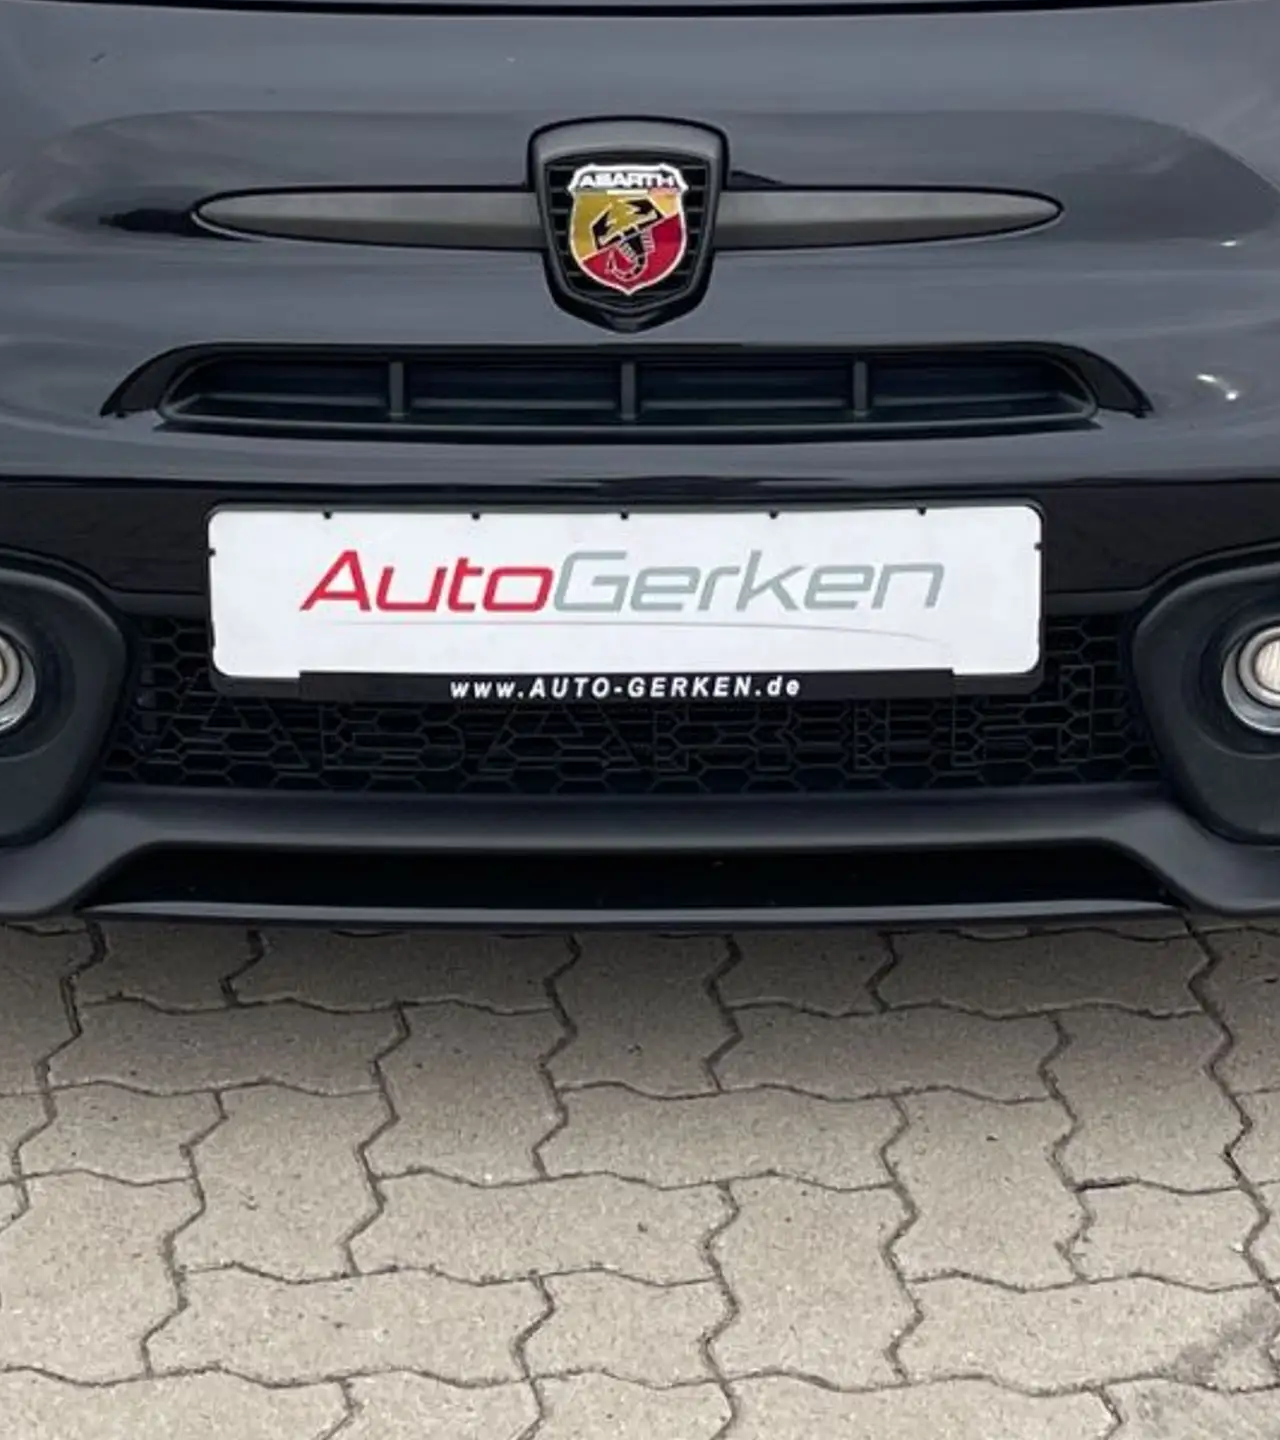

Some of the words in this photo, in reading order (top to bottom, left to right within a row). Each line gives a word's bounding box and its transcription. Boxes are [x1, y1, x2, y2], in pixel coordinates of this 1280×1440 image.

[579, 171, 677, 189] ABARTH
[299, 548, 946, 614] AutoGerken
[449, 674, 802, 700] www.AUTO-GERKEN.de
